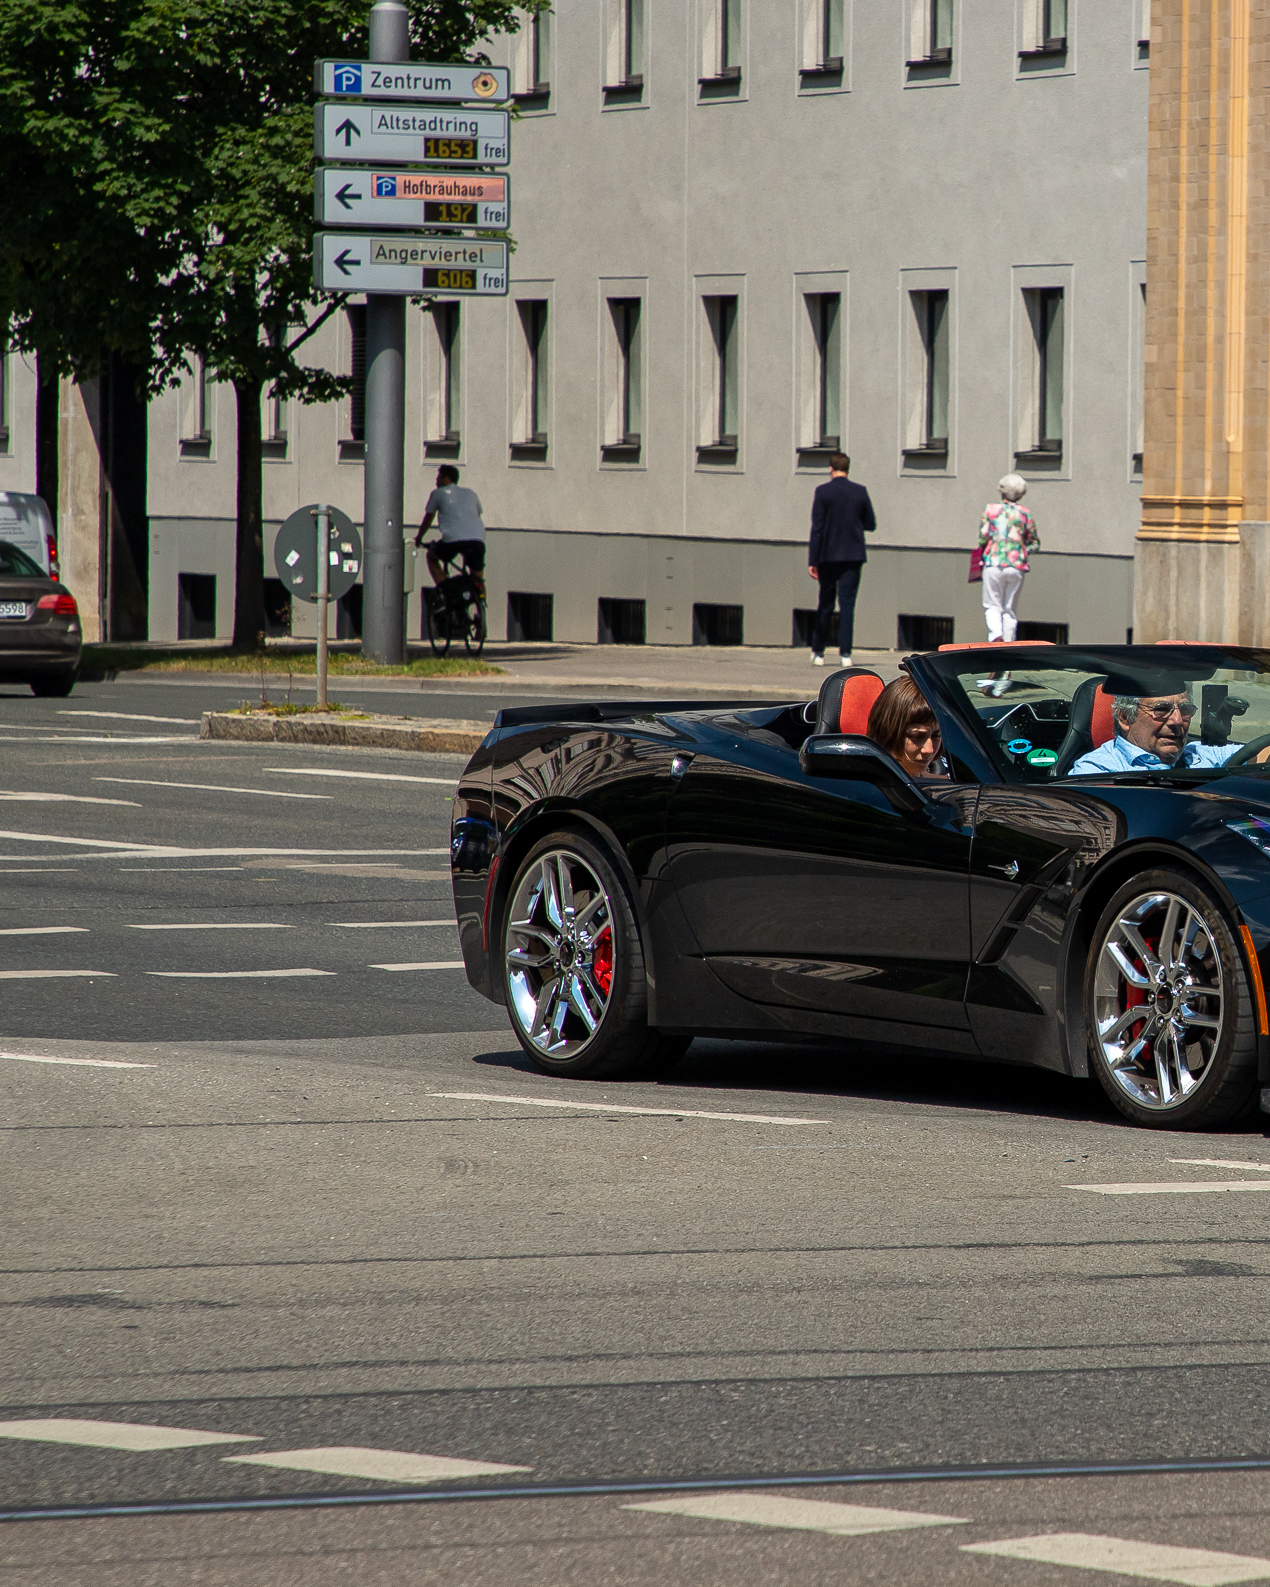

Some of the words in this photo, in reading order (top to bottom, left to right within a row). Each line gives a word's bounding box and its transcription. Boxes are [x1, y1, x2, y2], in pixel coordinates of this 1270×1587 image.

[342, 73, 355, 91] P
[370, 71, 452, 91] Zentrum
[377, 113, 479, 137] Altstadtring
[426, 138, 474, 158] 1653
[484, 143, 506, 159] frei
[382, 182, 392, 196] P
[403, 180, 484, 198] Hofbräuhaus
[439, 203, 473, 222] 197
[483, 206, 506, 222] frei
[375, 244, 484, 265] Angerviertel
[437, 269, 473, 288] 606
[482, 272, 505, 289] frei
[1038, 749, 1048, 758] 4
